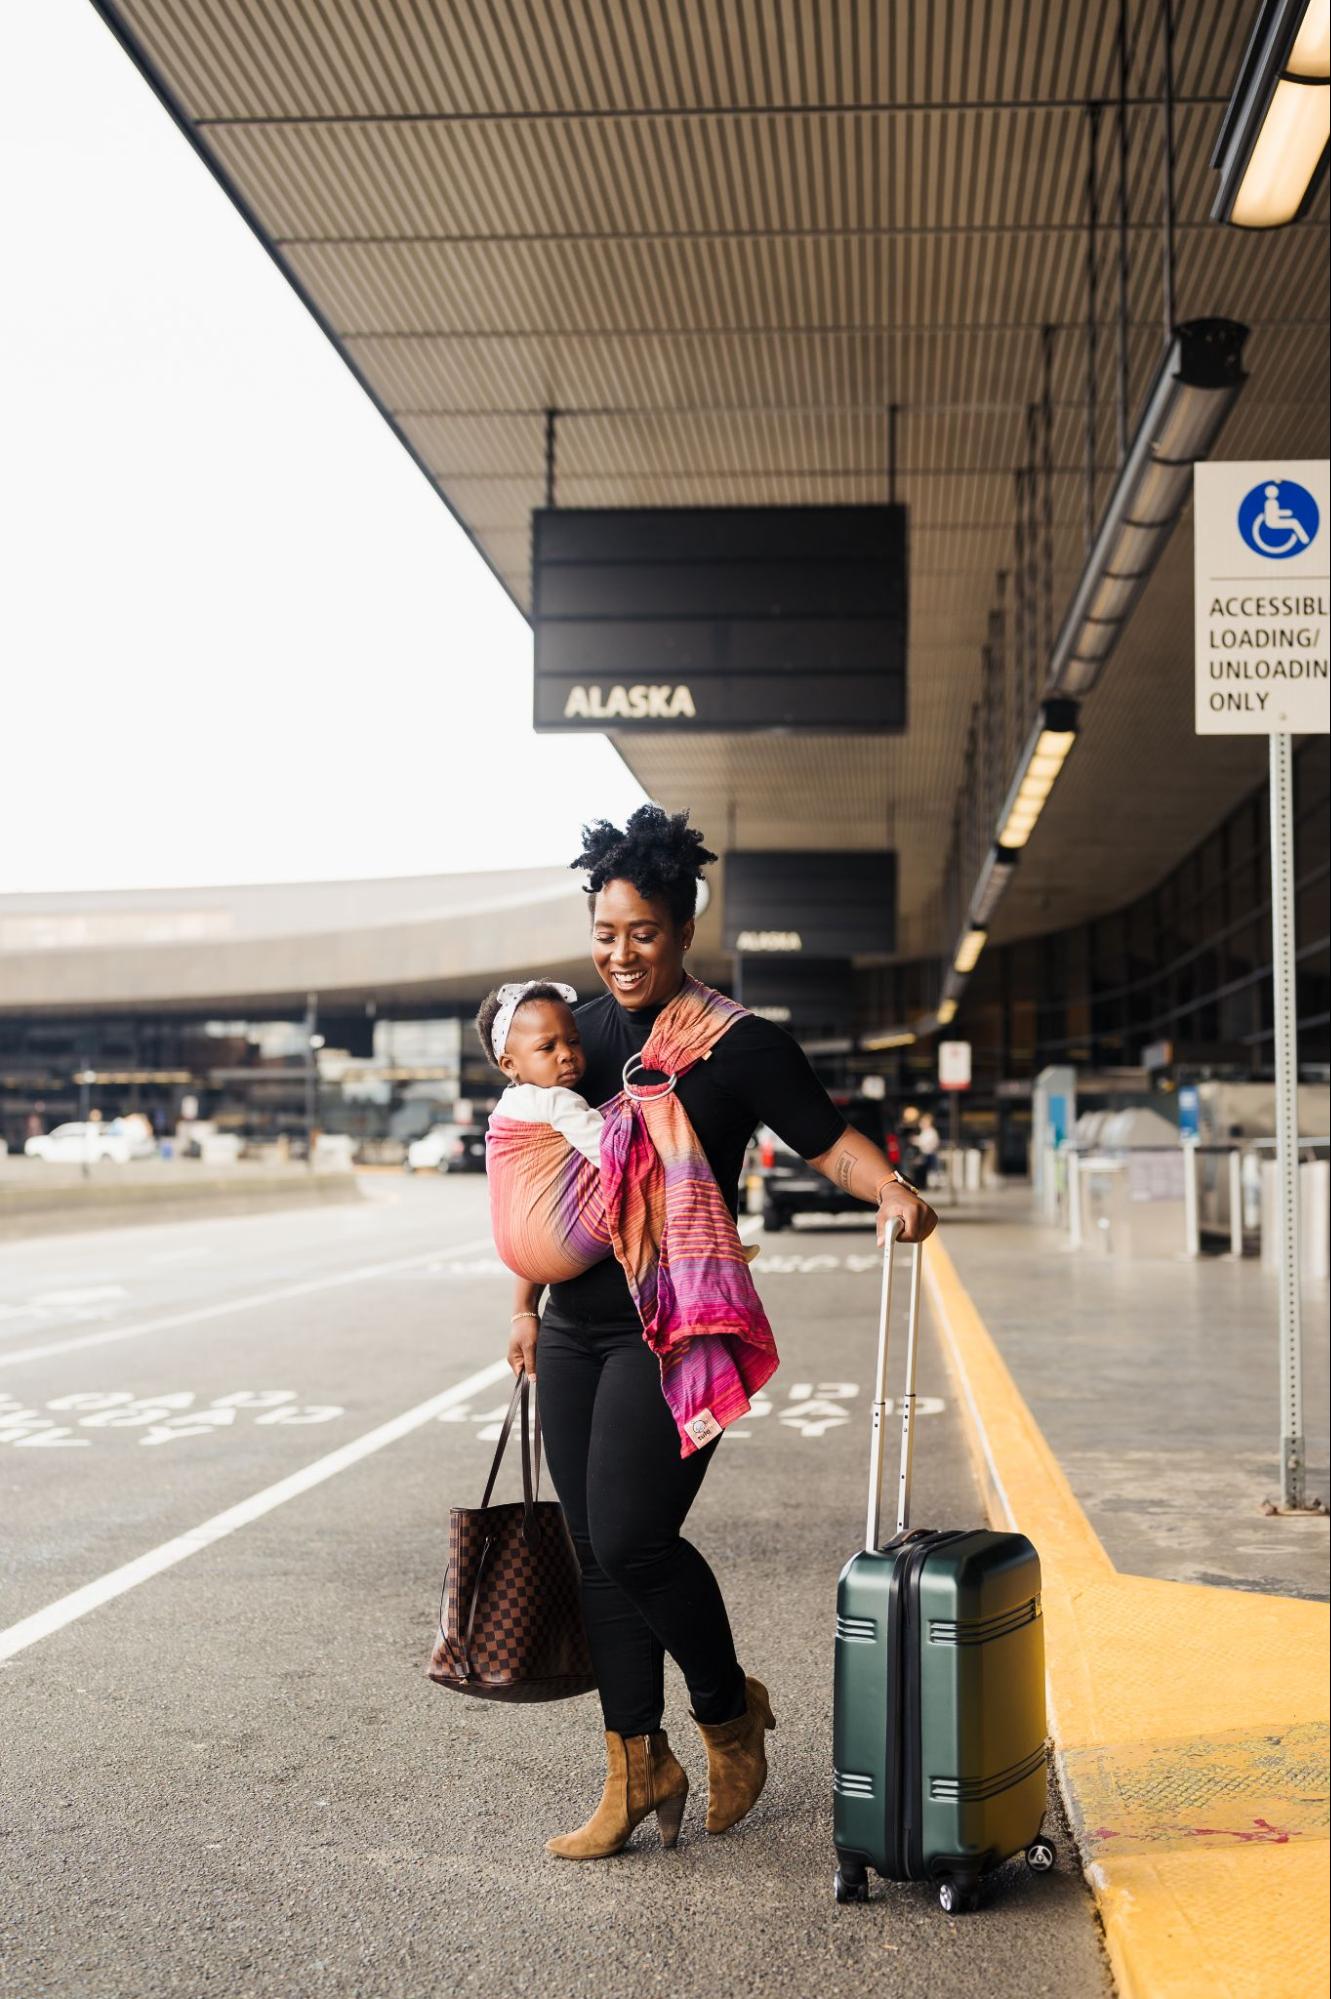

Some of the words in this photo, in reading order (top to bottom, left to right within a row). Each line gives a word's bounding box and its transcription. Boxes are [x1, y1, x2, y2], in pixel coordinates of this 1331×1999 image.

[1209, 596, 1329, 617] ACCESSIBL
[1210, 628, 1320, 649] LOADING/
[563, 684, 697, 719] ALASKA
[1209, 692, 1270, 712] ONLY
